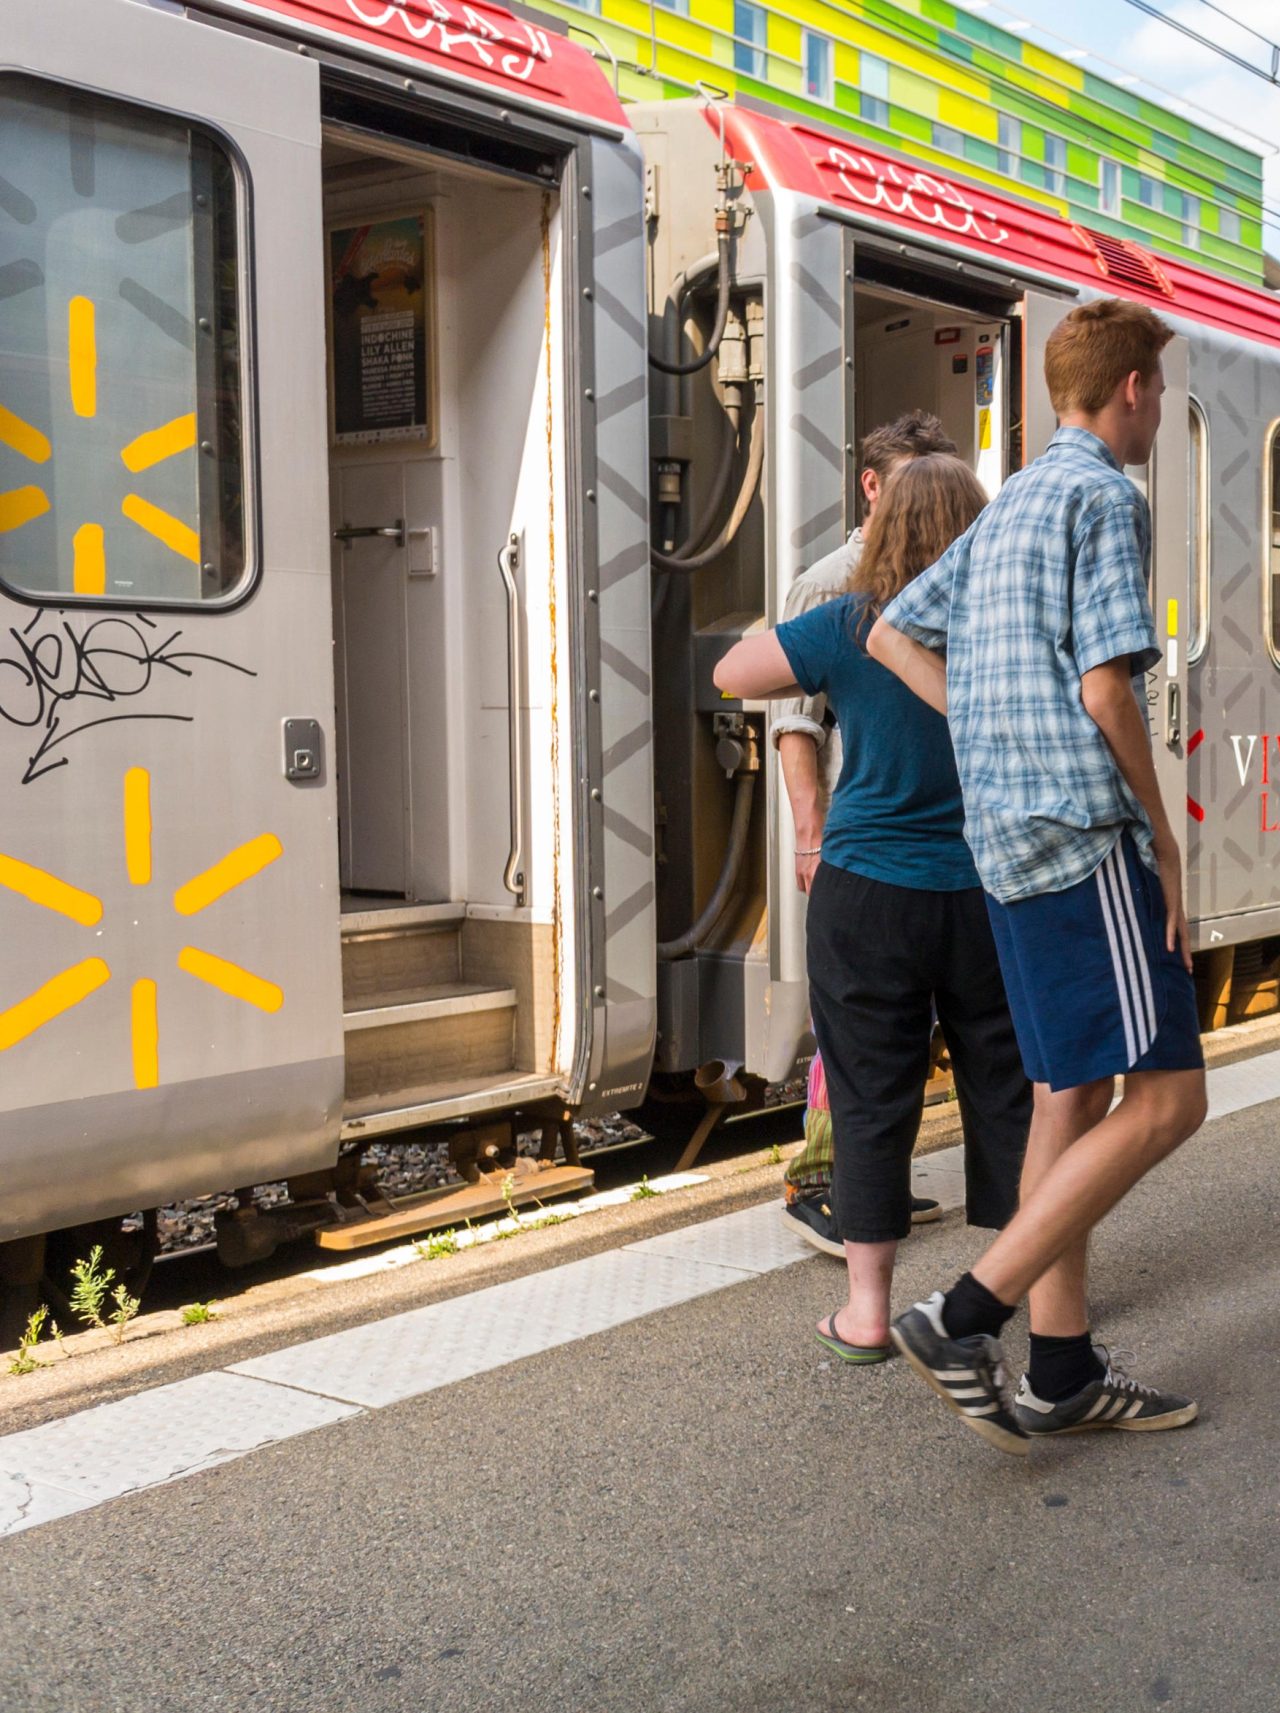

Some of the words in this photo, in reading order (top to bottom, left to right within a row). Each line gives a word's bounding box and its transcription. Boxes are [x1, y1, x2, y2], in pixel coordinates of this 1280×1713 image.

[361, 329, 414, 345] INDOCHINE
[361, 344, 381, 357] LILY
[383, 339, 414, 354] ALLEN
[361, 354, 389, 368] SHAKA
